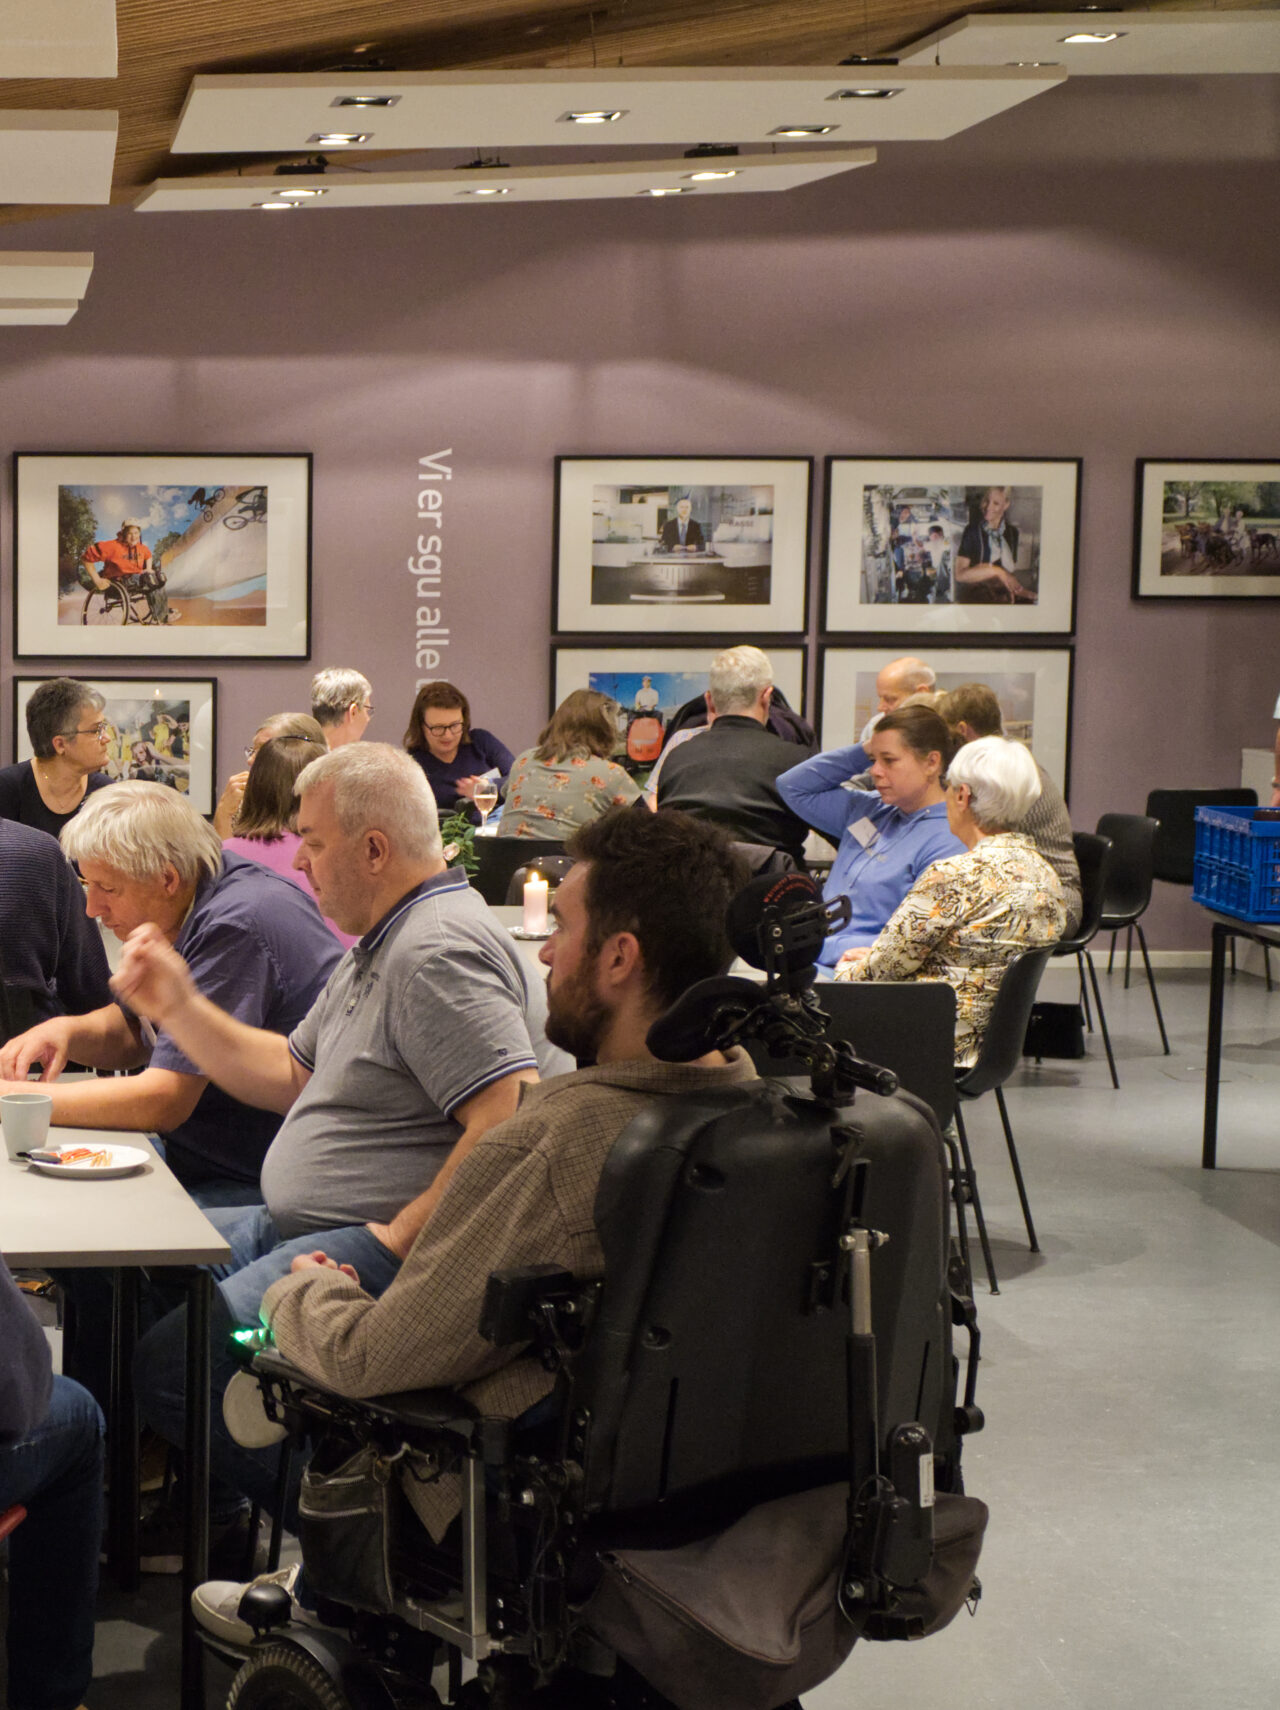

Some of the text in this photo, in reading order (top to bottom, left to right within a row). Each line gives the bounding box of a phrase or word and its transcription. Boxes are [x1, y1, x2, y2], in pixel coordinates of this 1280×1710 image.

[418, 448, 453, 480] Vi
[417, 489, 443, 529] er
[407, 534, 443, 598] sgu
[415, 606, 450, 670] alle
